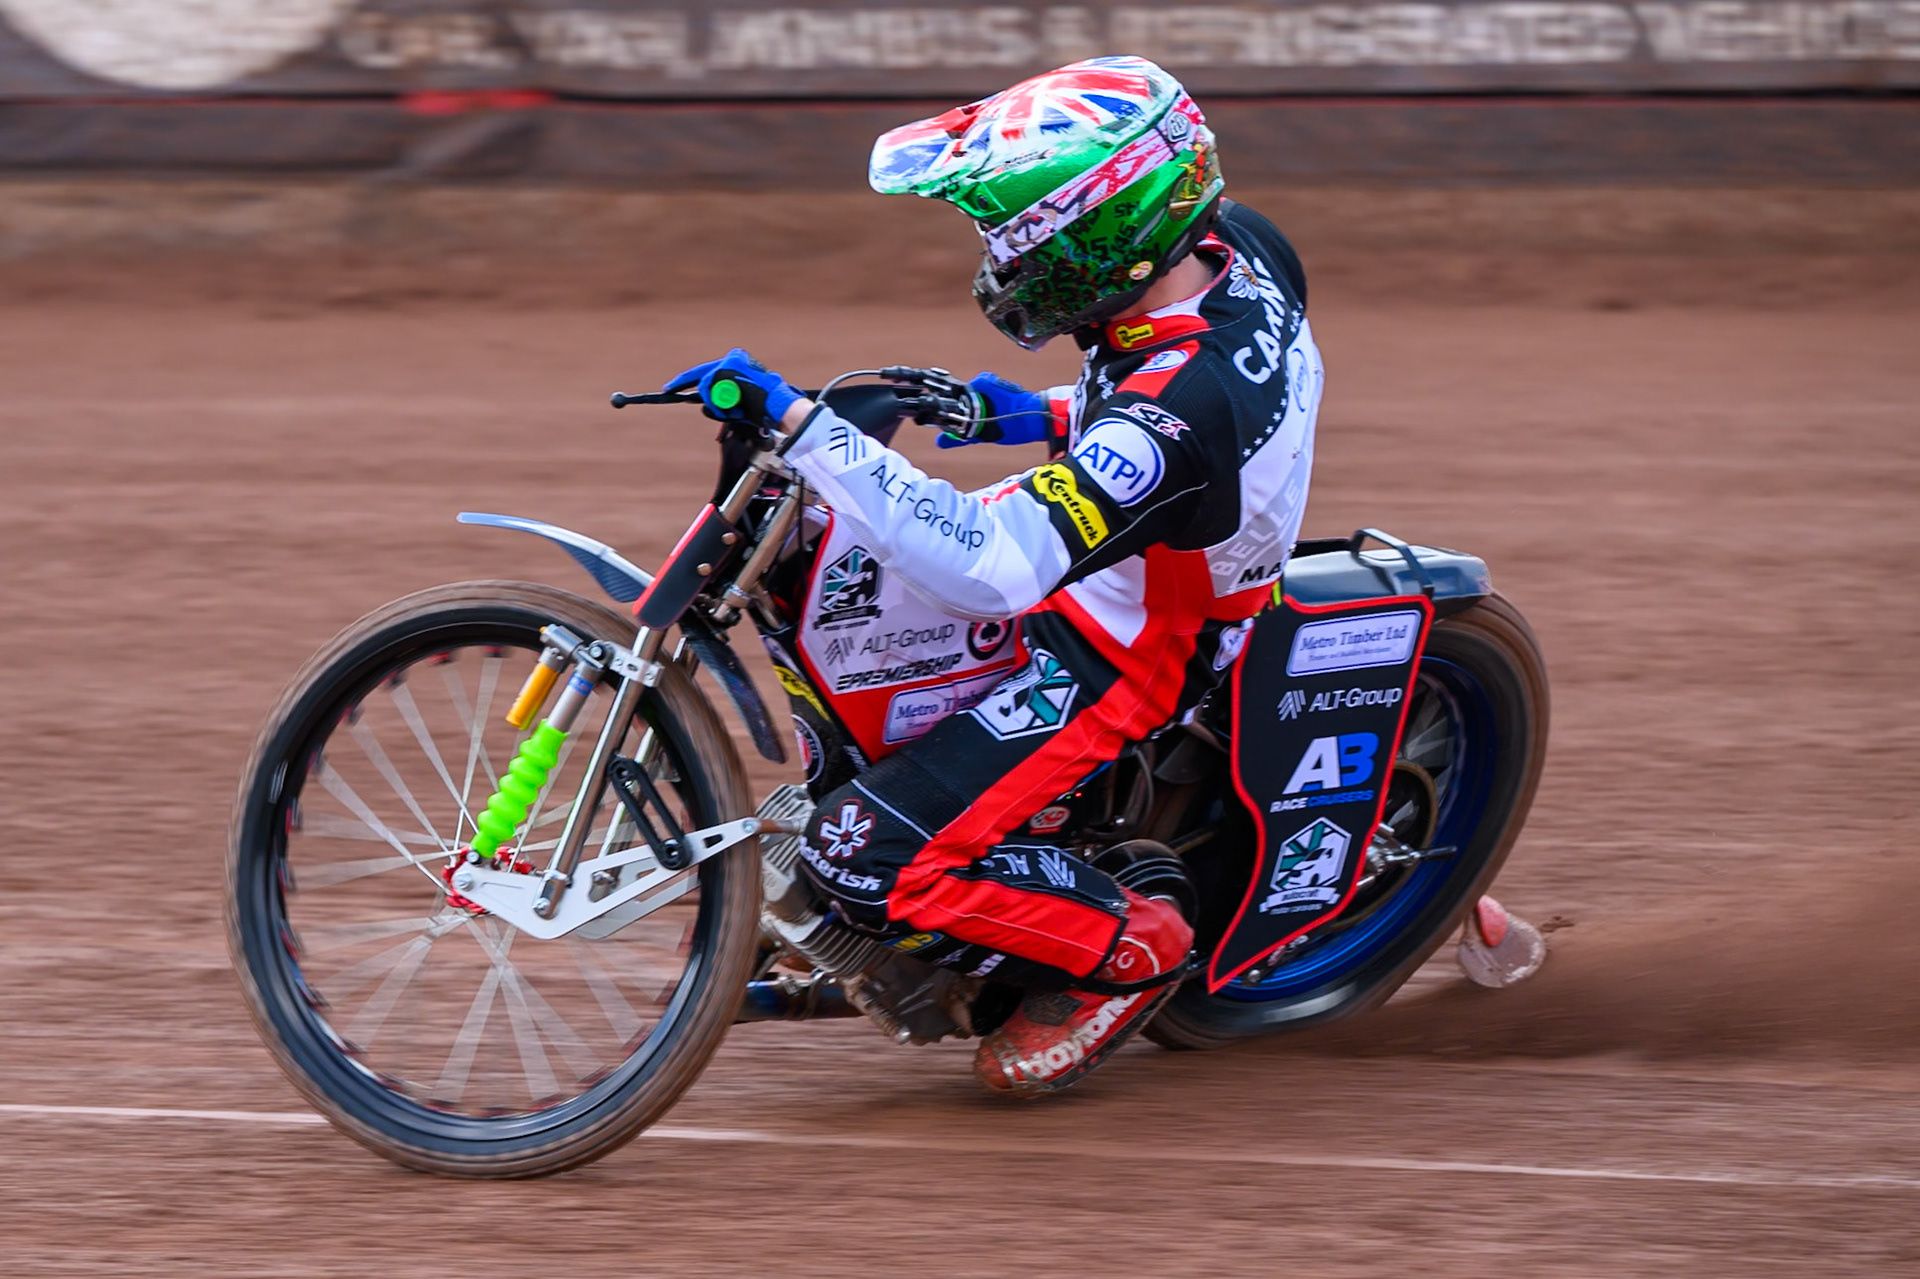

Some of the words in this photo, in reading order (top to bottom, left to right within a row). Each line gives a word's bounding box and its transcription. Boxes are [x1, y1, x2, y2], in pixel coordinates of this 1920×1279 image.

[1077, 442, 1145, 490] ATPI
[870, 464, 985, 551] ALT-Group
[1040, 469, 1099, 541] Kentruck
[1209, 478, 1301, 577] BELLE
[859, 623, 956, 656] ALT-Group
[1299, 637, 1338, 651] Metro
[1340, 629, 1384, 645] Timber
[1385, 625, 1408, 640] Ltd
[895, 704, 939, 719] Metro
[1309, 688, 1402, 712] ALT-Group
[1282, 732, 1379, 795] AB
[1270, 797, 1309, 813] RACE
